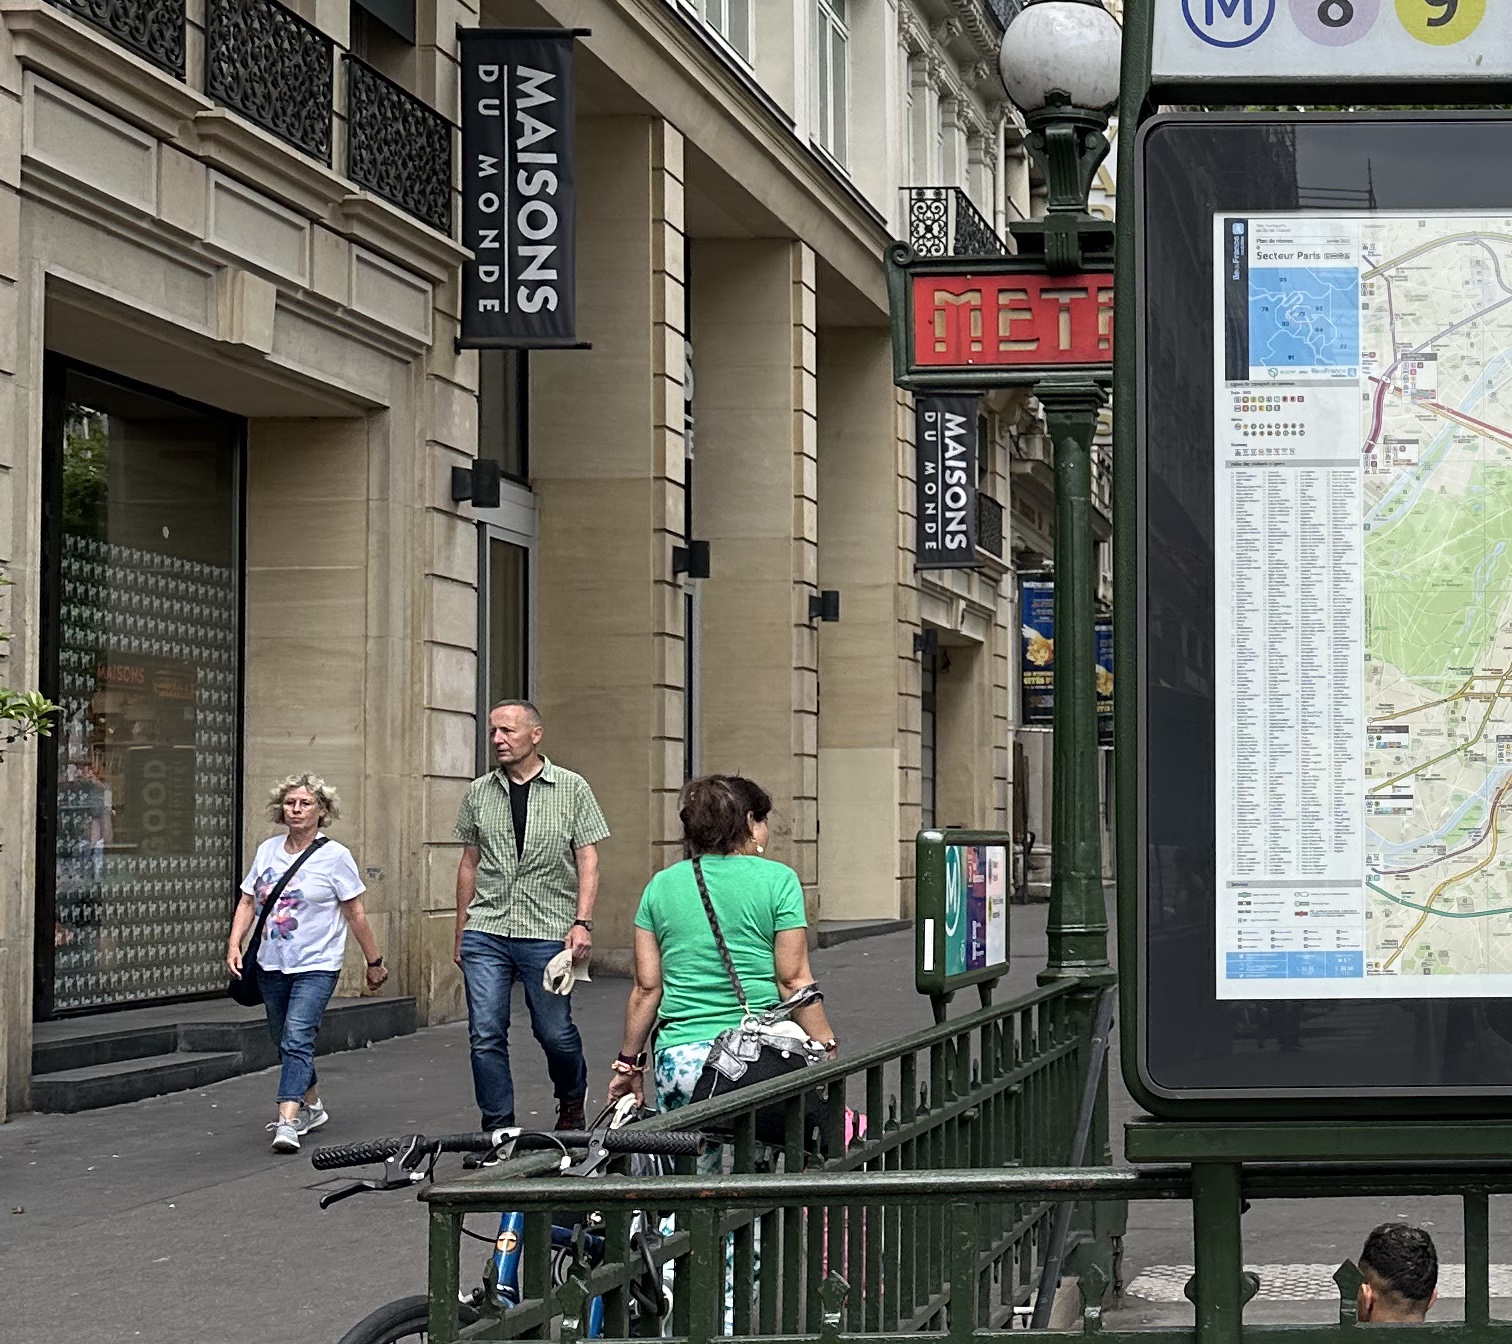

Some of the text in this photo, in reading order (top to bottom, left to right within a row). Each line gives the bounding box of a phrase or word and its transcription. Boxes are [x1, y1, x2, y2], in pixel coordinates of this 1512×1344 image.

[477, 64, 500, 313] DU MONDE
[515, 64, 559, 314] MAISONS
[1256, 251, 1321, 261] Secteur Paris
[923, 411, 937, 551] DU MONDE
[944, 411, 968, 551] MAISONS
